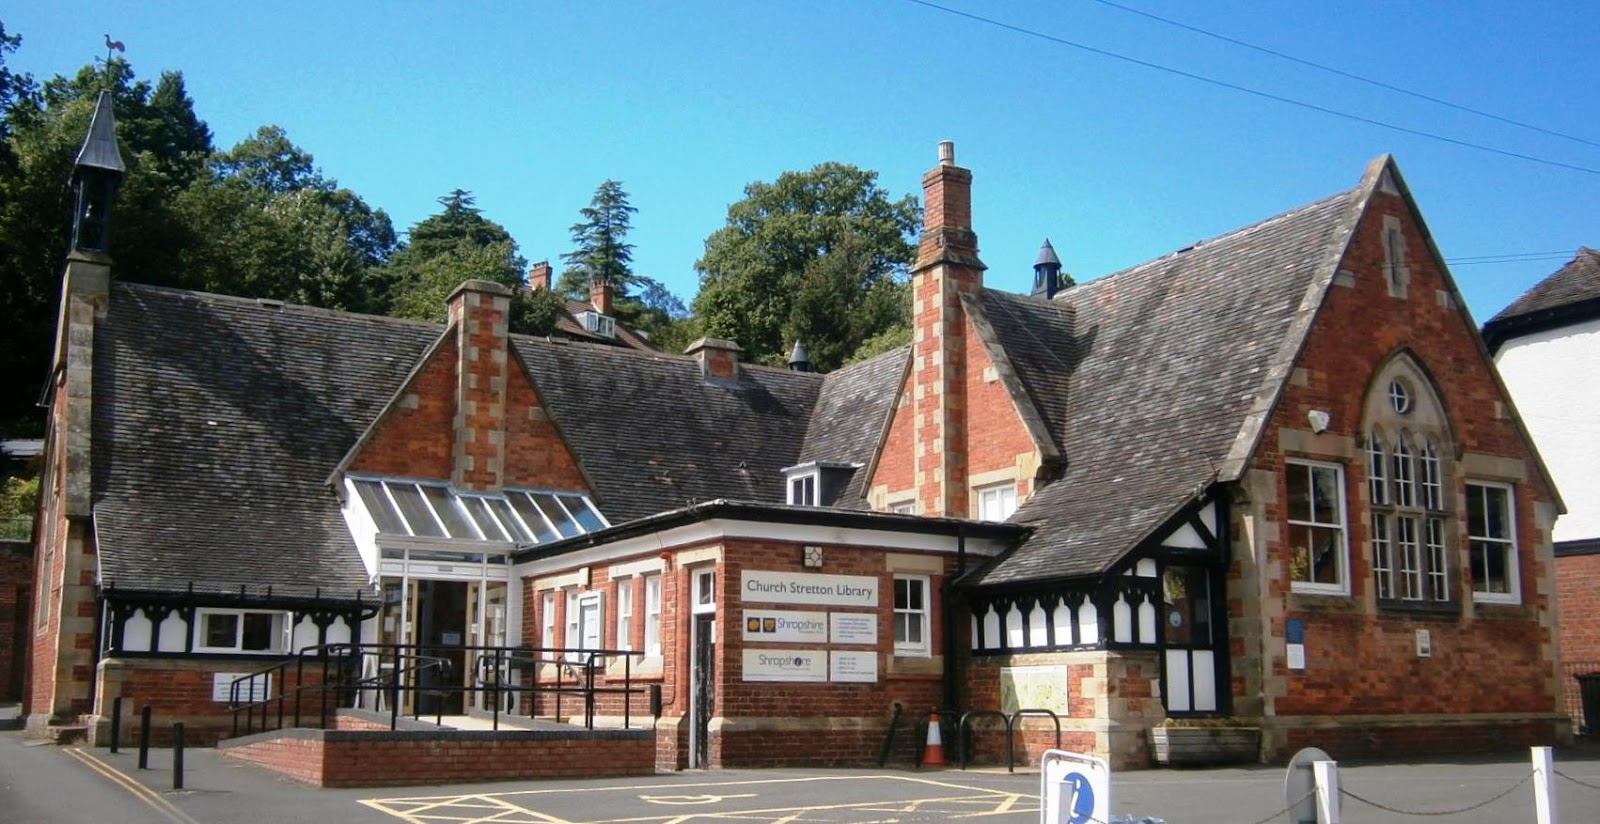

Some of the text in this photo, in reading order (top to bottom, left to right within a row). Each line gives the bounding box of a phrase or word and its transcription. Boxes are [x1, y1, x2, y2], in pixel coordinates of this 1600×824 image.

[747, 579, 872, 599] Church Stretton Library
[778, 617, 823, 631] Shropshire
